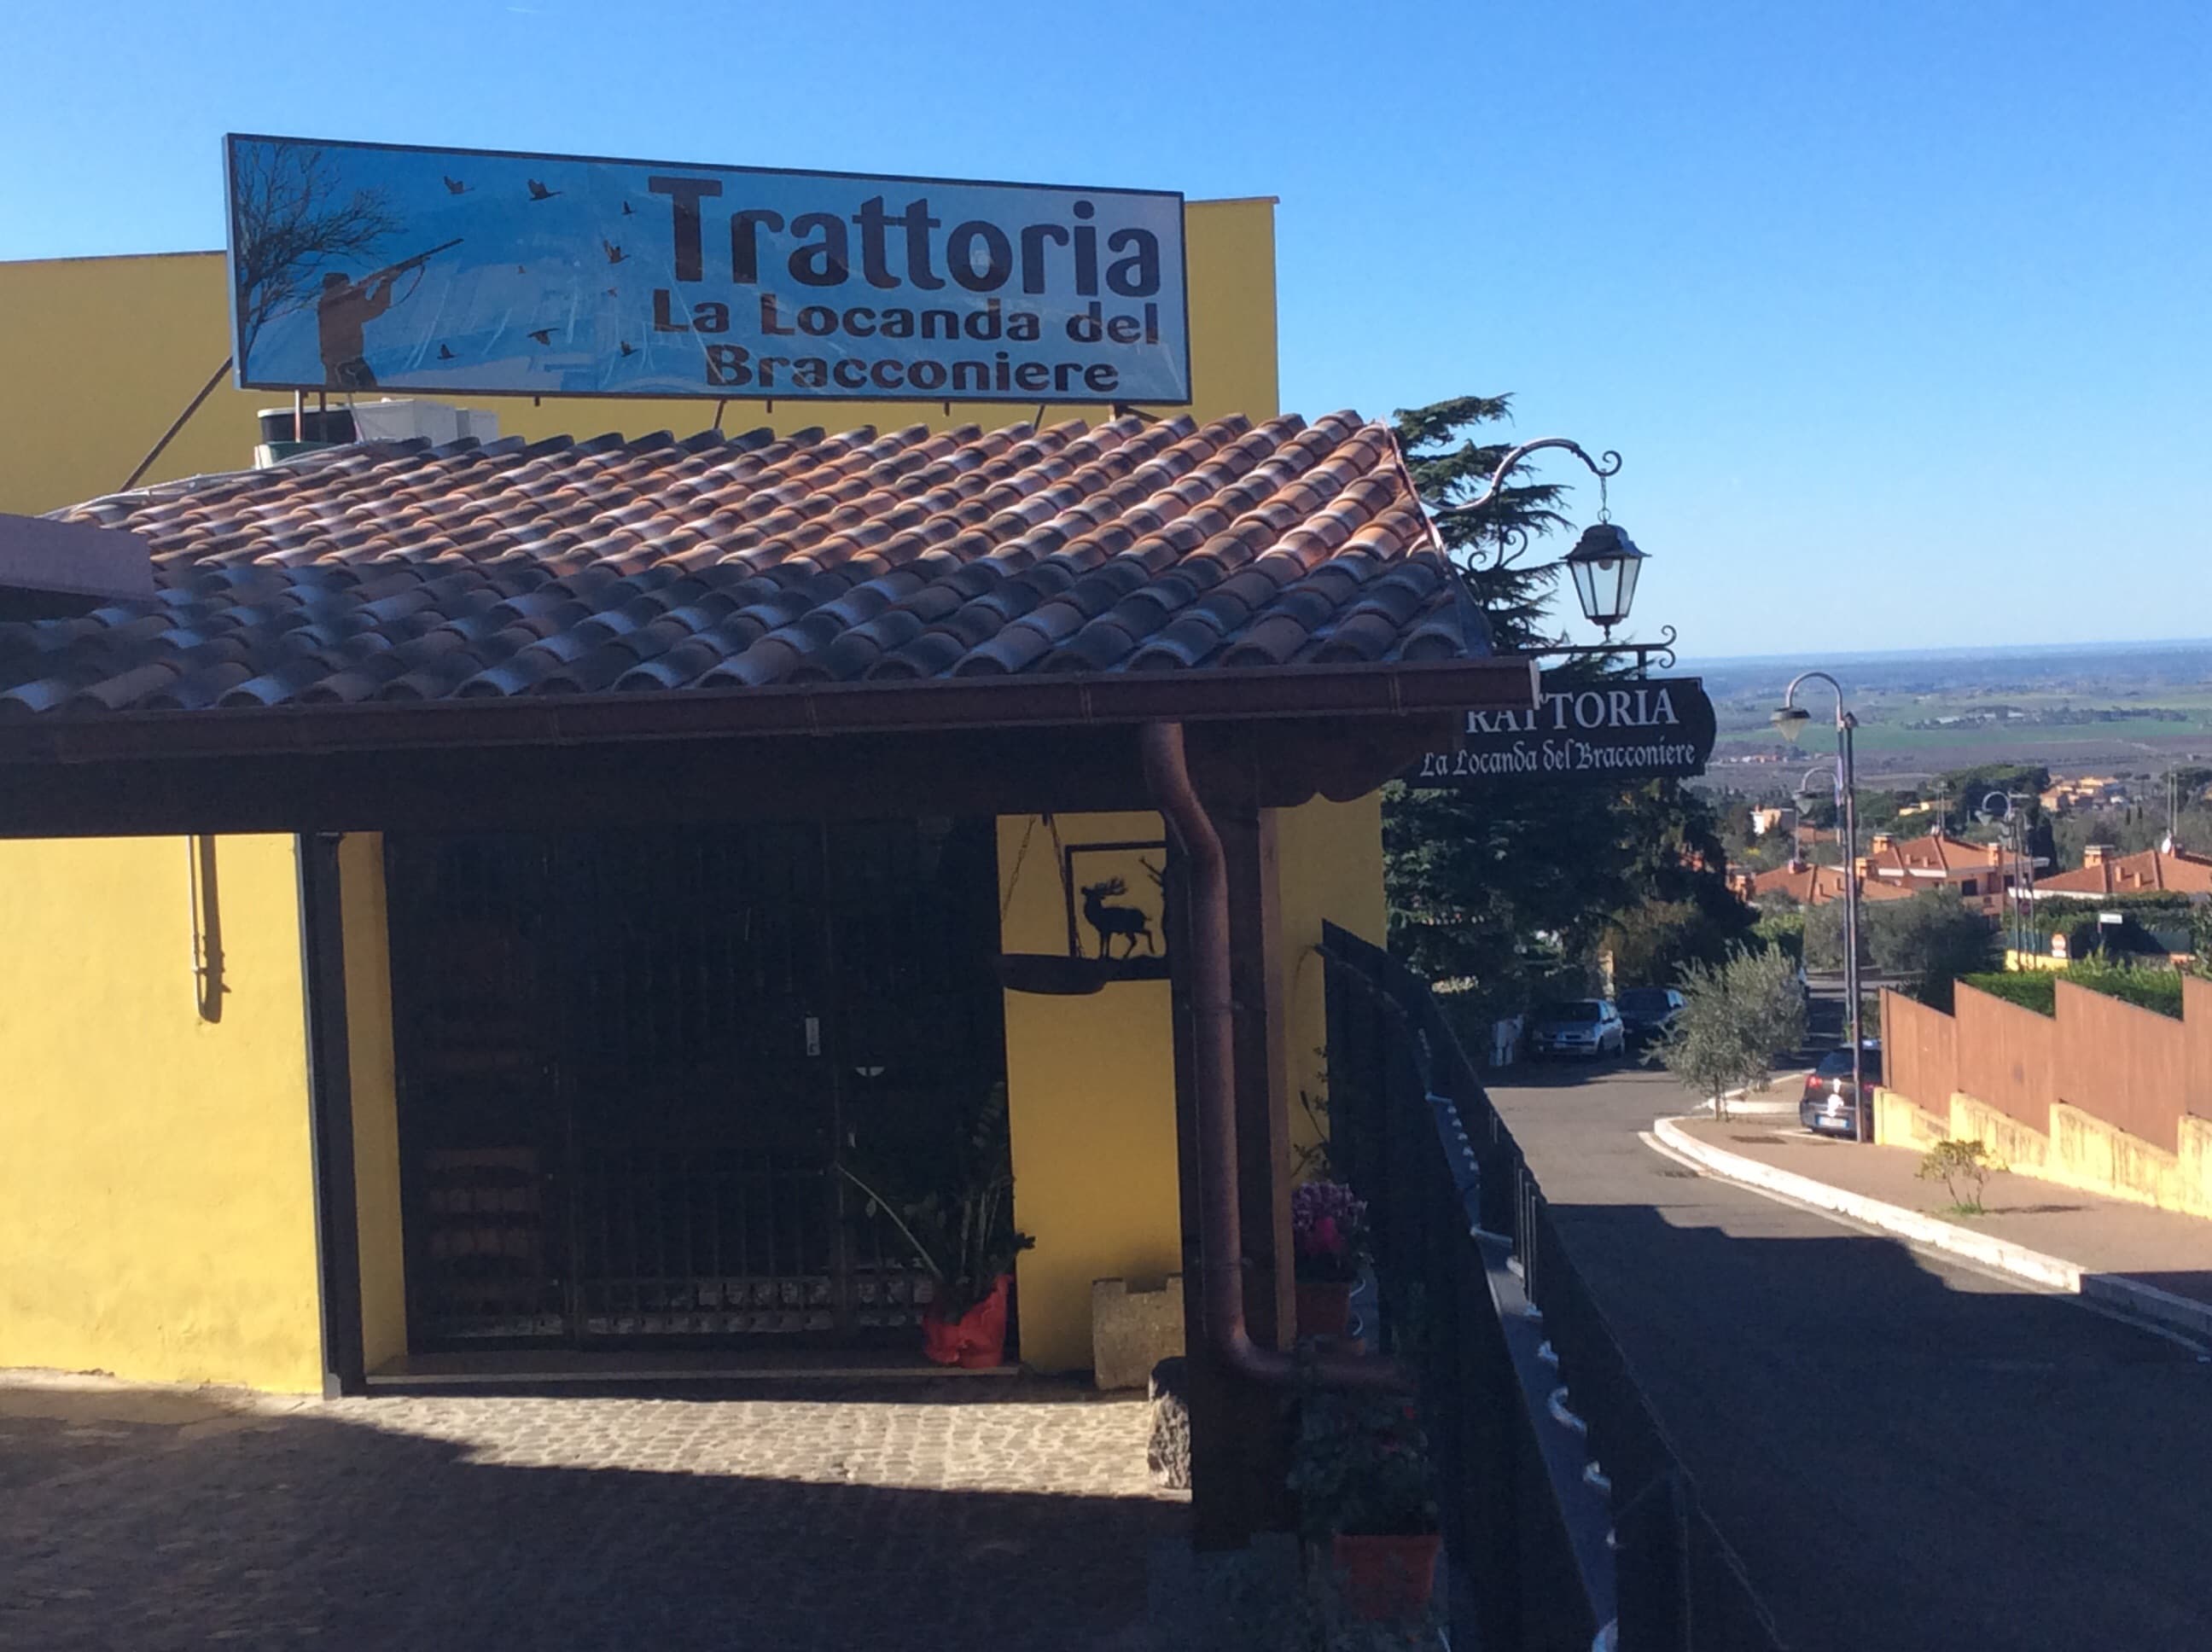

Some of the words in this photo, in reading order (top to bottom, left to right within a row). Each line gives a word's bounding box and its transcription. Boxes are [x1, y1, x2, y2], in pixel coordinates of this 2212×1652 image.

[648, 176, 1161, 298] Trattoria
[653, 289, 730, 334] La
[760, 293, 1040, 342] Locanda
[1065, 299, 1159, 346] del
[705, 344, 1120, 393] Bracconiere
[1465, 688, 1679, 734] RATTORIA
[1419, 751, 1448, 777] La
[1452, 740, 1538, 777] Locanda
[1542, 738, 1575, 771] del
[1576, 736, 1696, 771] Bracconiere
